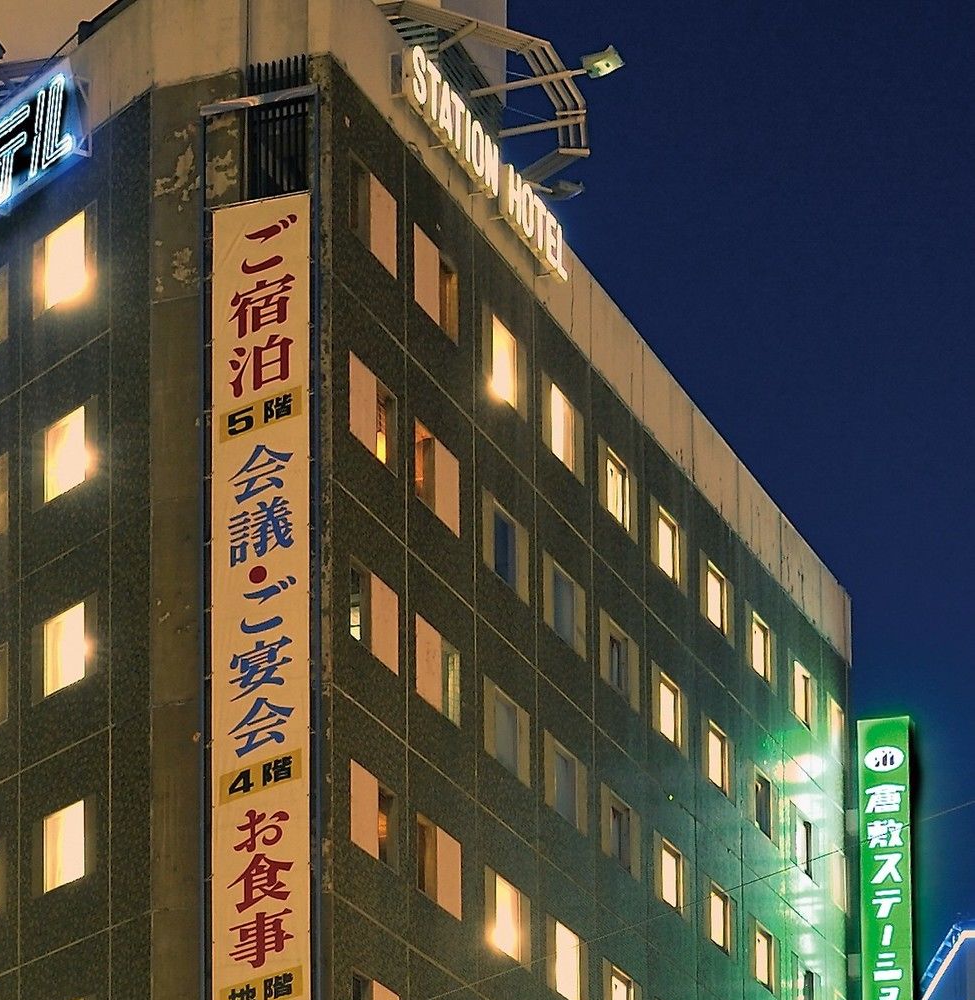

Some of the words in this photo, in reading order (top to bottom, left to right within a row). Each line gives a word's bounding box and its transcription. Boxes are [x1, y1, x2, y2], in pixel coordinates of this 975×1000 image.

[412, 45, 500, 197] STATION
[508, 163, 568, 282] HOTEL
[228, 213, 298, 399] ご宿泊
[227, 392, 293, 437] 5階
[228, 756, 293, 795] 4階
[227, 809, 295, 969] お食事
